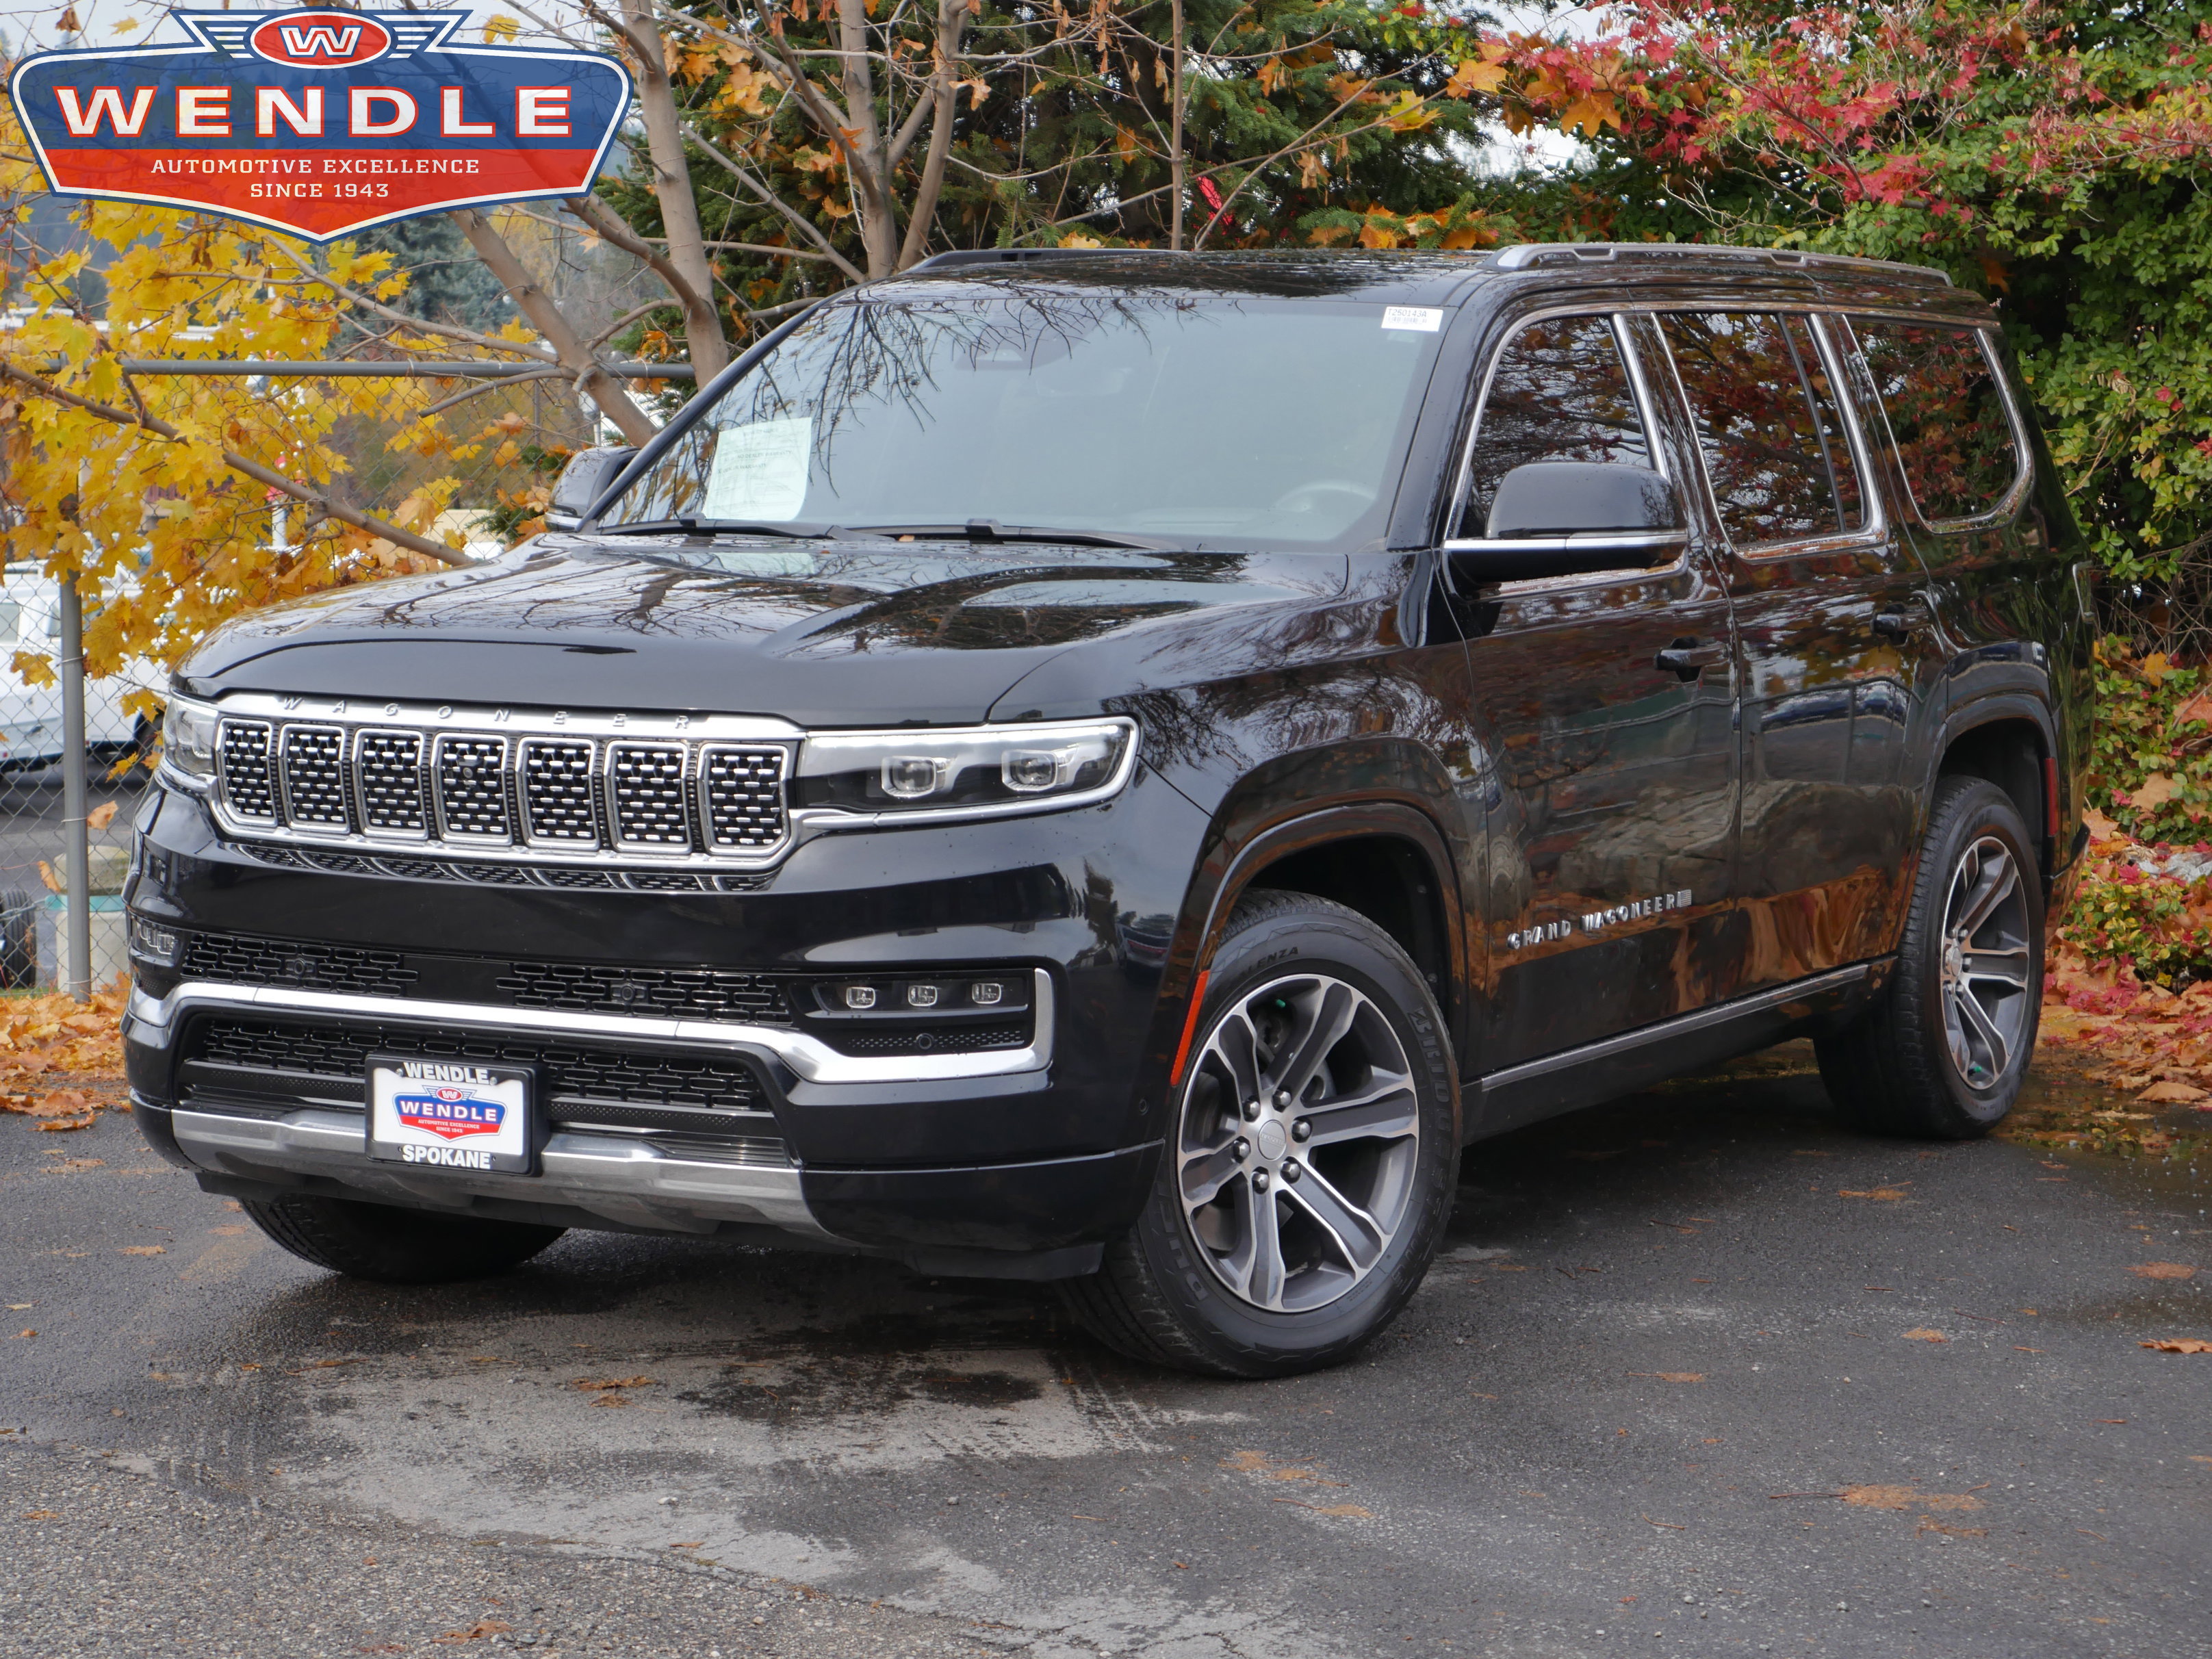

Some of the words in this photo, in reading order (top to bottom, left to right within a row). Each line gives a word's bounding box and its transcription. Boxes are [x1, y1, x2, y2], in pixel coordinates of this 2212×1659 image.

[282, 696, 691, 730] WAGONEER
[1507, 919, 1571, 950] GRAND
[1580, 893, 1675, 931] WAGONEER
[403, 1062, 491, 1085] WENDLE
[400, 1101, 497, 1122] WENDLE
[402, 1144, 491, 1170] SPOKANE
